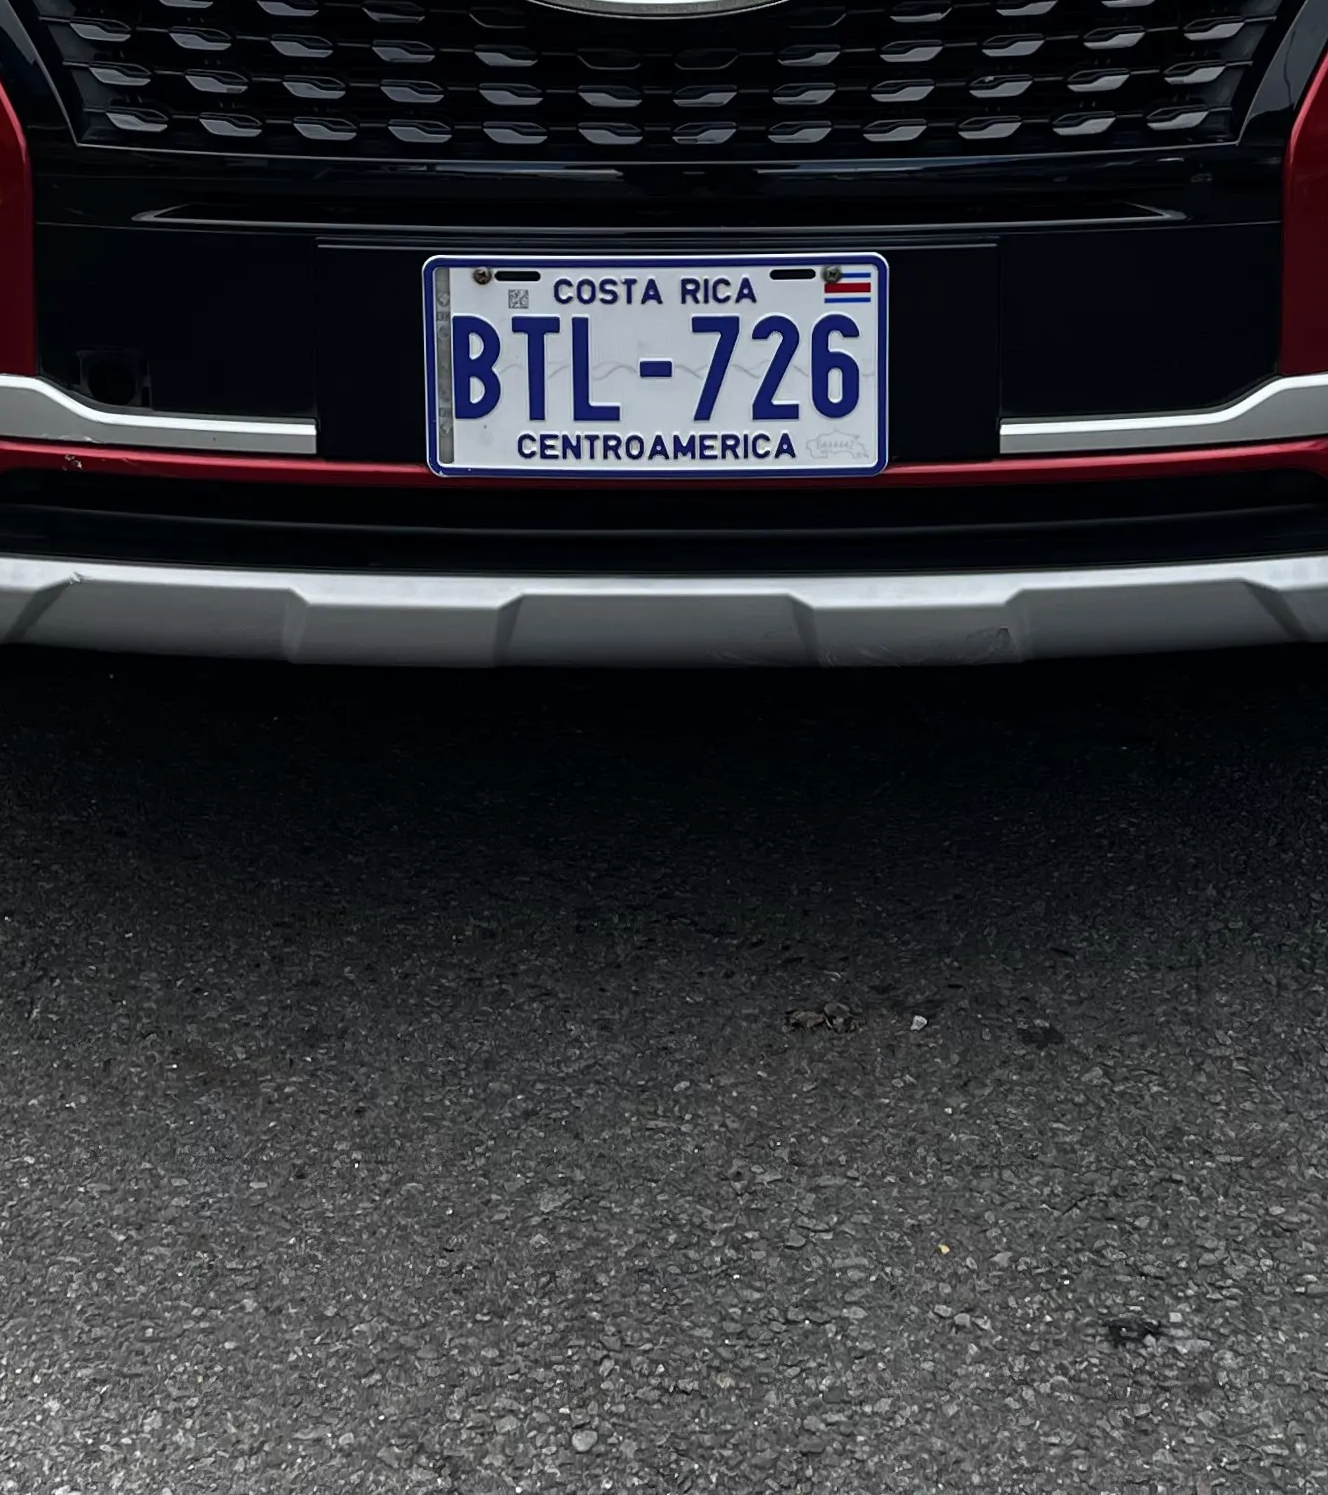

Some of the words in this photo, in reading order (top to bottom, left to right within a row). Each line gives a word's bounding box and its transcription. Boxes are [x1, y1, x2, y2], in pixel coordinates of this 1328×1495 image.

[553, 277, 663, 305] COSTA
[680, 276, 758, 304] RICA
[517, 431, 797, 461] CENTROAMERICA
